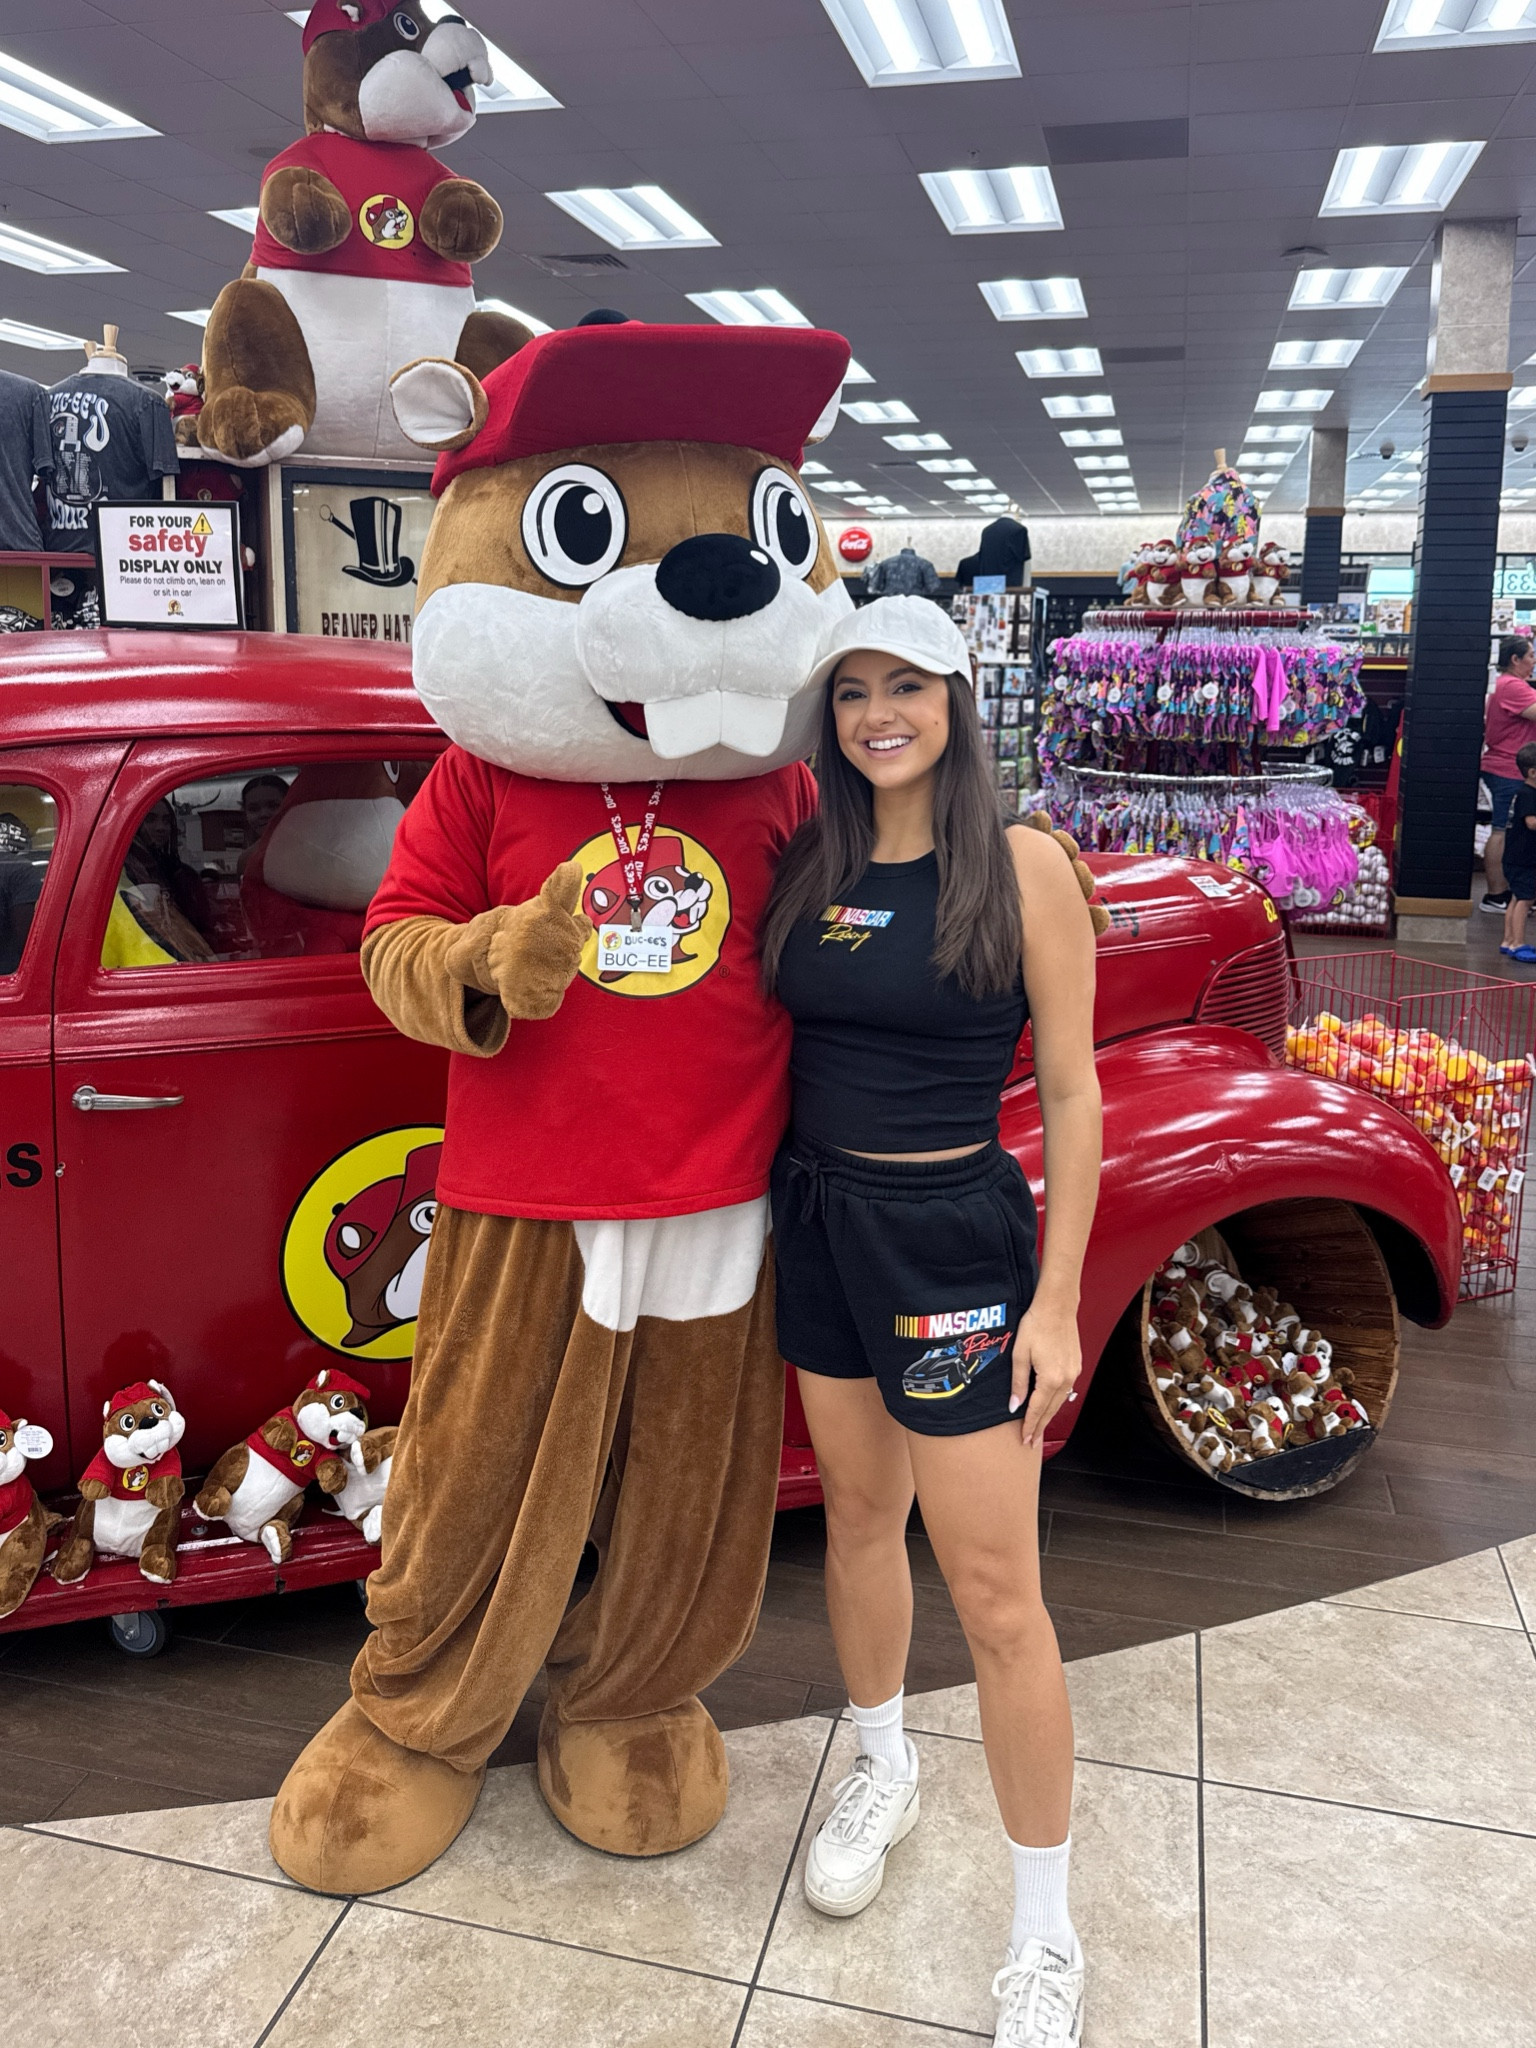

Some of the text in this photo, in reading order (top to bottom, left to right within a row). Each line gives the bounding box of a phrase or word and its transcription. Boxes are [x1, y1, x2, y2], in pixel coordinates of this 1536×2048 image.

[50, 391, 110, 452] UC-EE'S
[129, 516, 192, 529] FOR YOUR
[128, 528, 208, 558] safety
[119, 559, 223, 575] DISPLAY ONLY
[120, 576, 226, 587] Please do not climb on, lean on
[153, 588, 192, 598] or sit in car
[321, 612, 379, 640] BEAVER
[842, 906, 892, 928] NASCAR
[819, 923, 872, 952] Racing
[604, 953, 669, 968] BUC-EE
[0, 1142, 43, 1188] S
[928, 1303, 1002, 1338] NASCAR
[963, 1331, 1013, 1361] Racing
